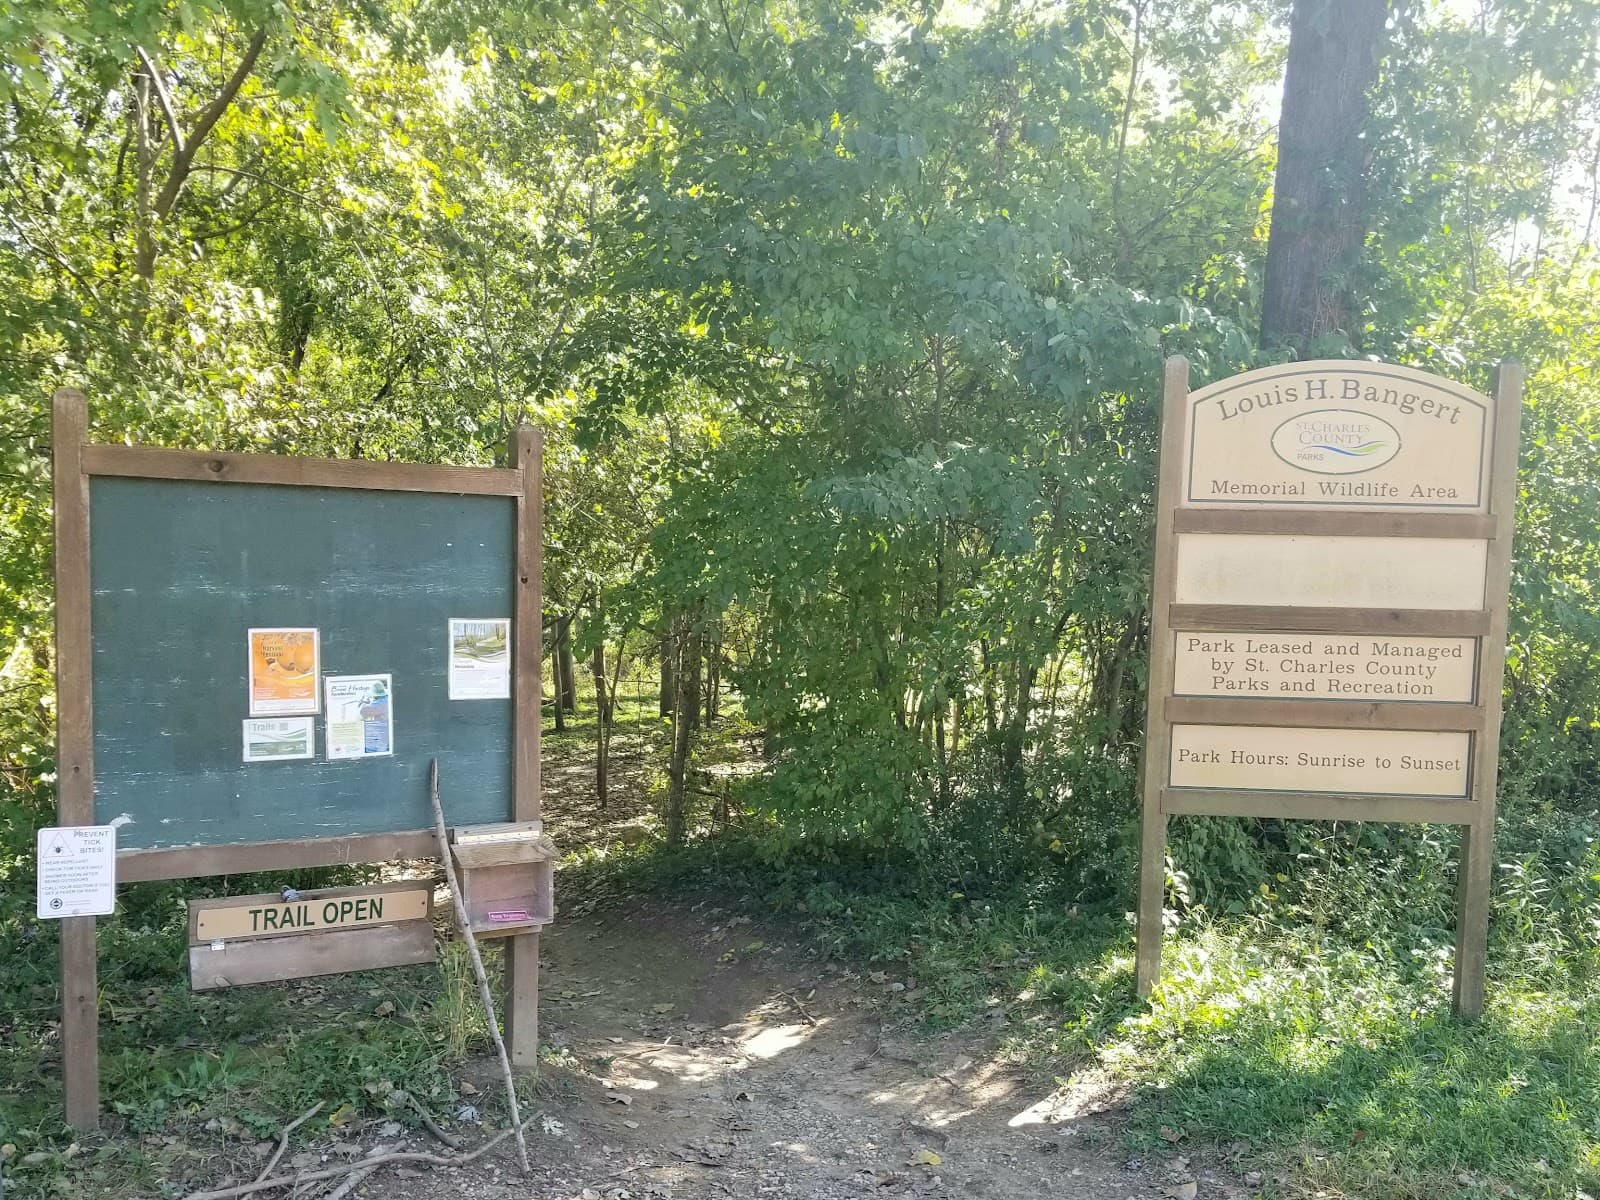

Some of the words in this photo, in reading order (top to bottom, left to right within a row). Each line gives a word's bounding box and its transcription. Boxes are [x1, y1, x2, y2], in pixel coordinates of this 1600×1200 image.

[1216, 384, 1298, 421] Louis
[1305, 379, 1335, 401] H.
[1341, 379, 1462, 425] Bangert
[1311, 420, 1371, 433] CHARLES
[1299, 431, 1364, 445] COUNTY
[1297, 453, 1326, 461] PARKS
[1211, 480, 1306, 496] Memorial
[1318, 481, 1399, 498] Wildlife
[1410, 483, 1459, 499] Area
[1187, 638, 1235, 654] Park
[1245, 640, 1313, 656] Leased
[1324, 641, 1360, 657] and
[1372, 642, 1463, 661] Managed
[1211, 658, 1235, 676] by
[1245, 659, 1270, 673] St.
[1279, 659, 1356, 675] Charles
[1366, 661, 1438, 679] County
[1212, 676, 1270, 692] Parks
[1279, 678, 1315, 693] and
[1328, 679, 1435, 695] Recreation
[1178, 748, 1221, 764] Park
[1230, 750, 1289, 767] Hours:
[1297, 752, 1365, 769] Sunrise
[1375, 756, 1392, 770] to
[1400, 756, 1462, 772] Sunset
[74, 830, 109, 838] PREVENT
[248, 905, 316, 932] TRAIL
[322, 897, 384, 925] OPEN
